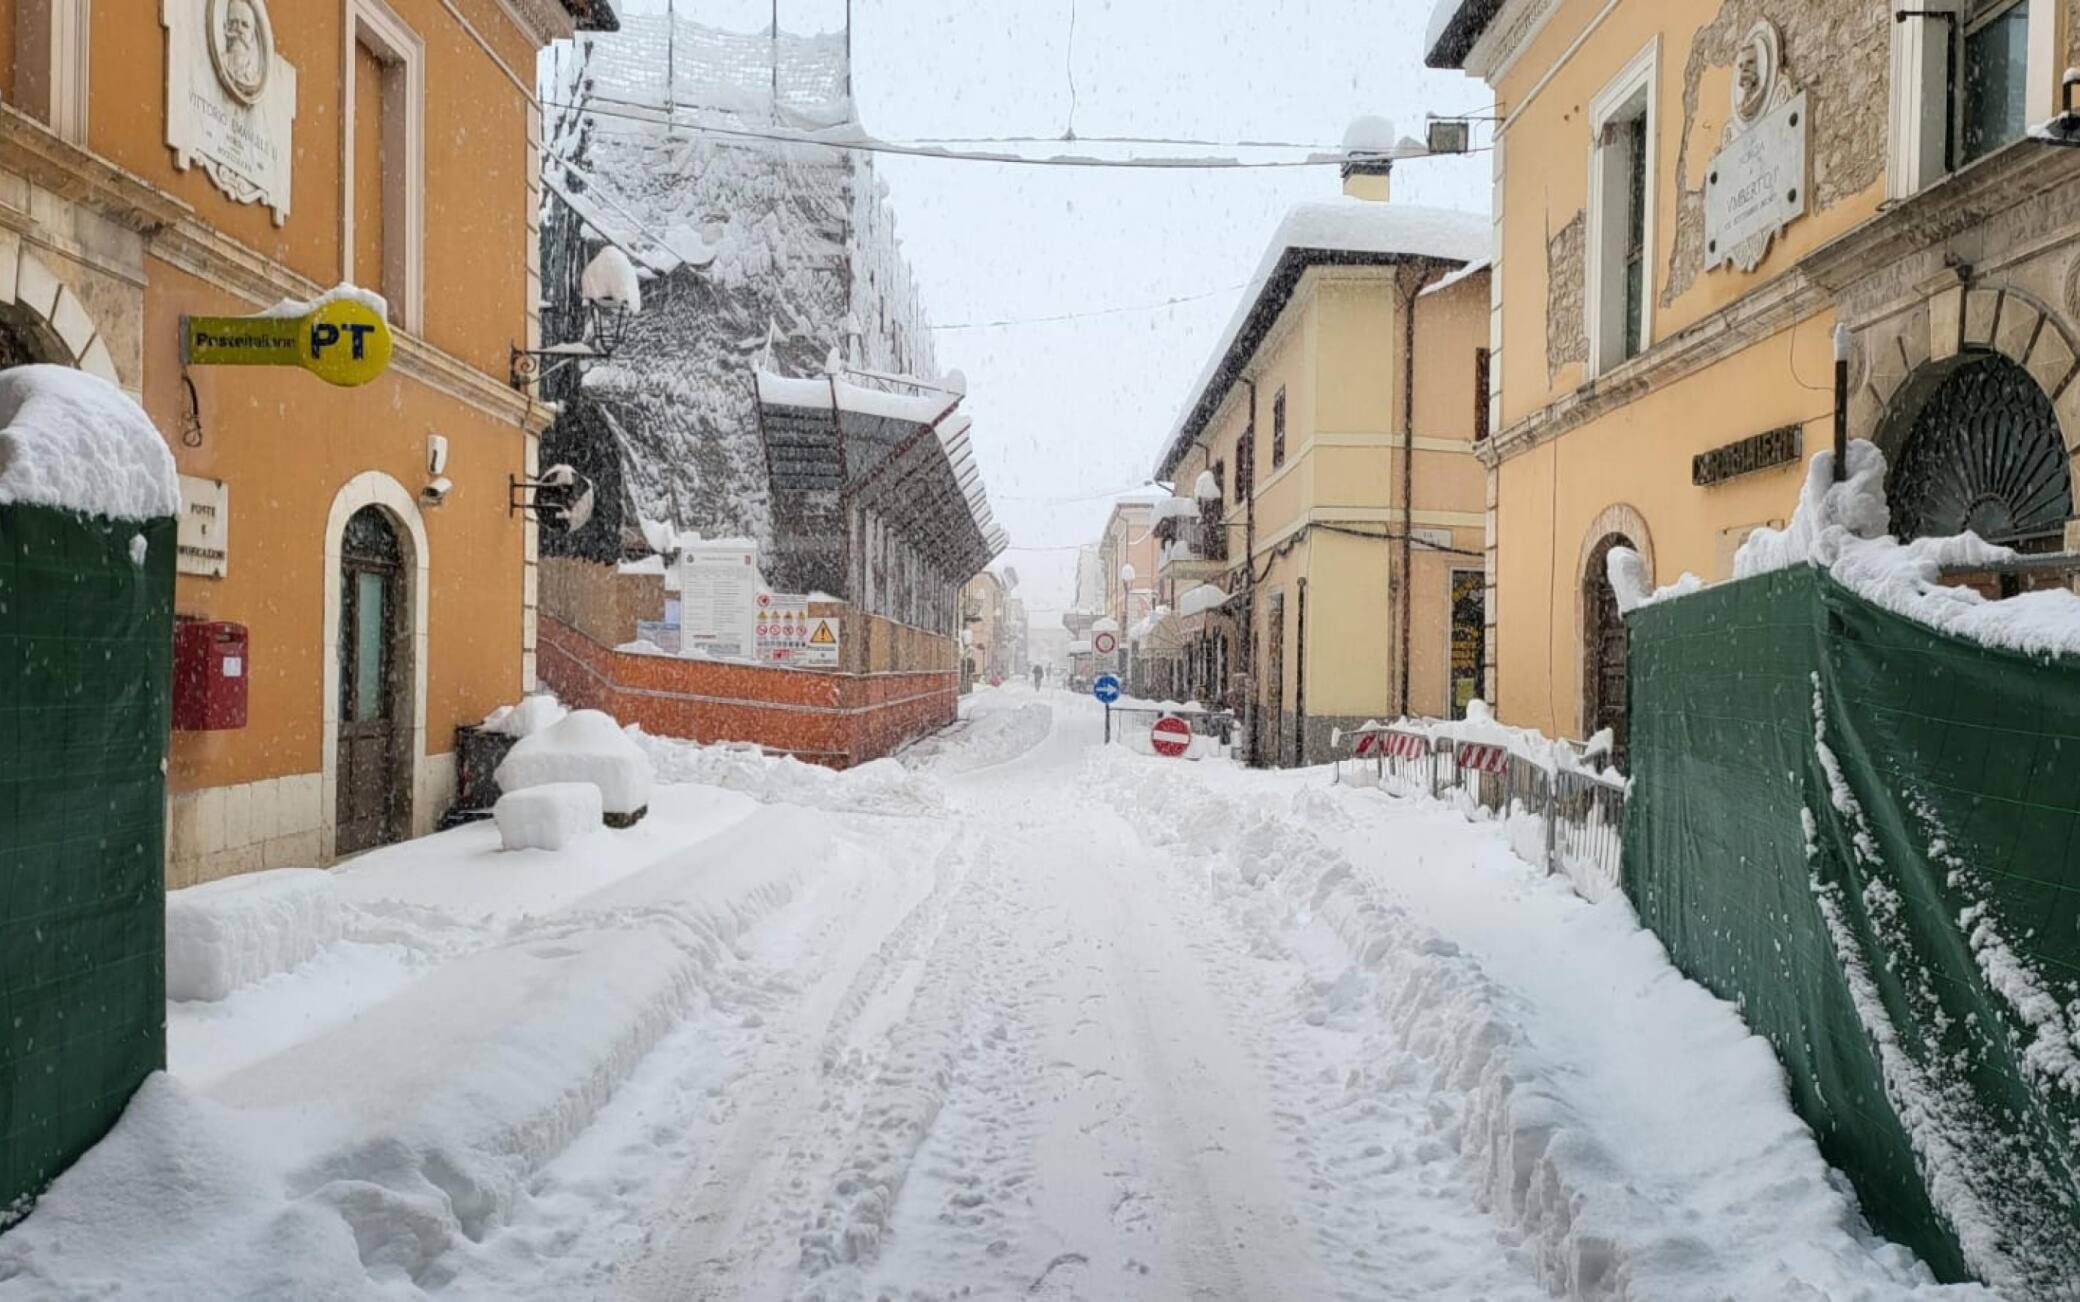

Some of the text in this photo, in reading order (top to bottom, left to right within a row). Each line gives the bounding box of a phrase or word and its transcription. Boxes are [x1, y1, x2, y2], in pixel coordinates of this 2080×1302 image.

[311, 323, 375, 360] PT
[191, 503, 216, 518] POSTE
[201, 524, 207, 535] E
